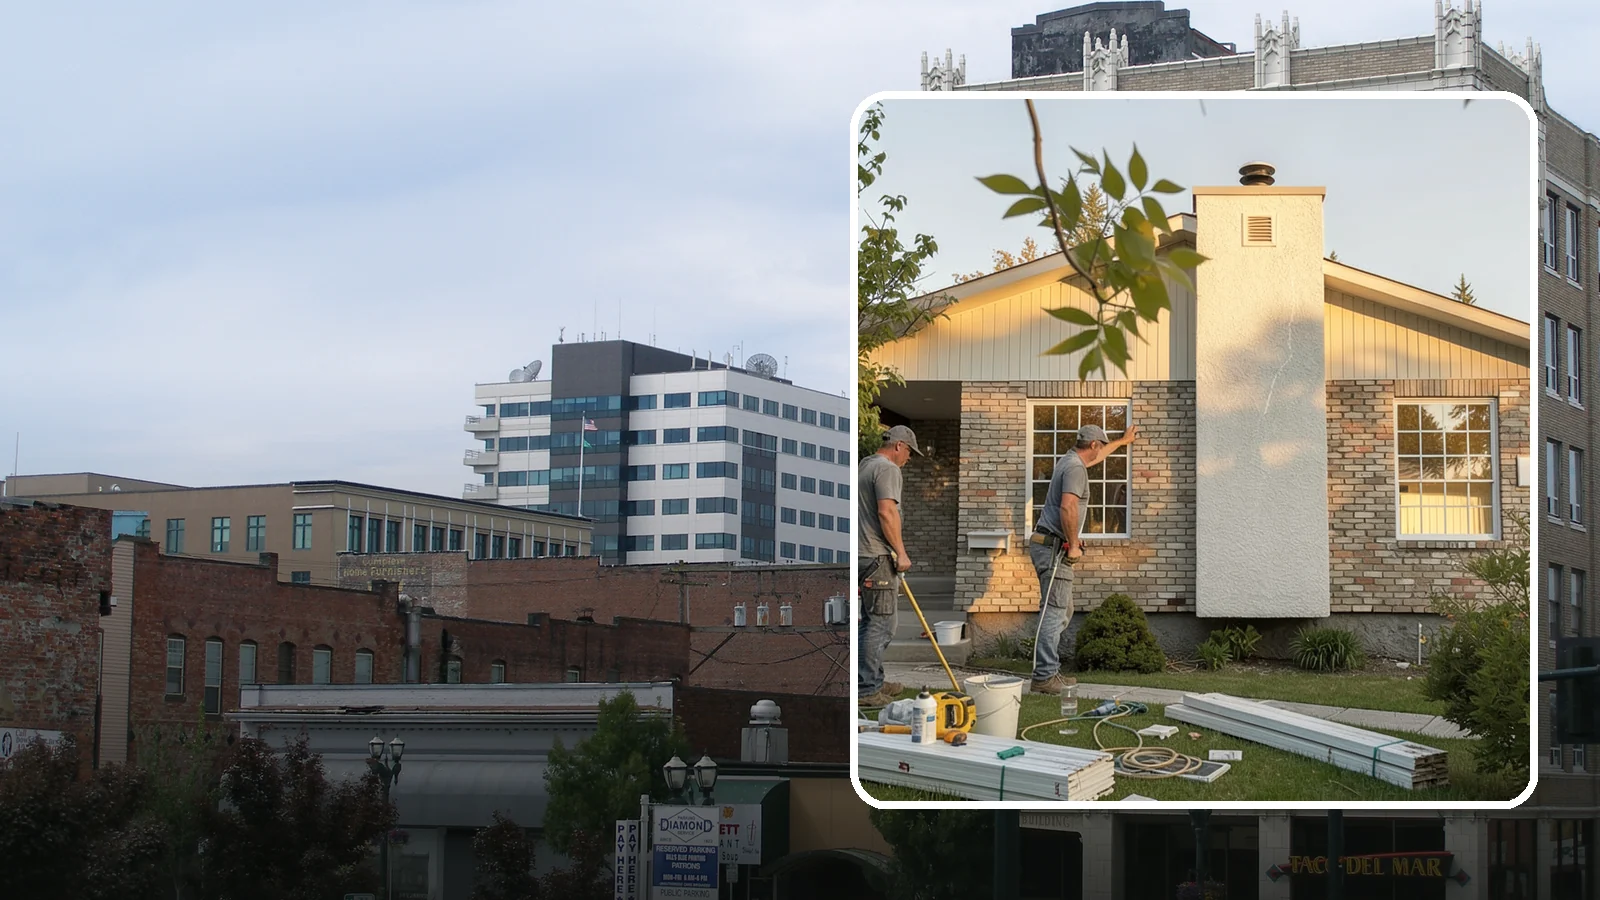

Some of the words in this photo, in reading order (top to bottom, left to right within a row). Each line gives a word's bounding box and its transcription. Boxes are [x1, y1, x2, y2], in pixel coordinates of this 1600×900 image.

[343, 568, 368, 577] Home
[370, 566, 427, 577] Furnishers
[660, 818, 713, 832] DIAMOND
[1022, 816, 1070, 828] BUILDING
[617, 825, 625, 852] PAY
[628, 824, 637, 852] PAY
[656, 845, 688, 853] RESERVED
[722, 852, 738, 862] Soup
[672, 862, 700, 870] PATRONS
[1345, 856, 1384, 876] DEL
[1392, 857, 1442, 877] MAR
[616, 856, 625, 893] HERE
[627, 855, 636, 893] HERE
[661, 889, 681, 897] PUBLIC
[684, 890, 710, 898] PARKING
